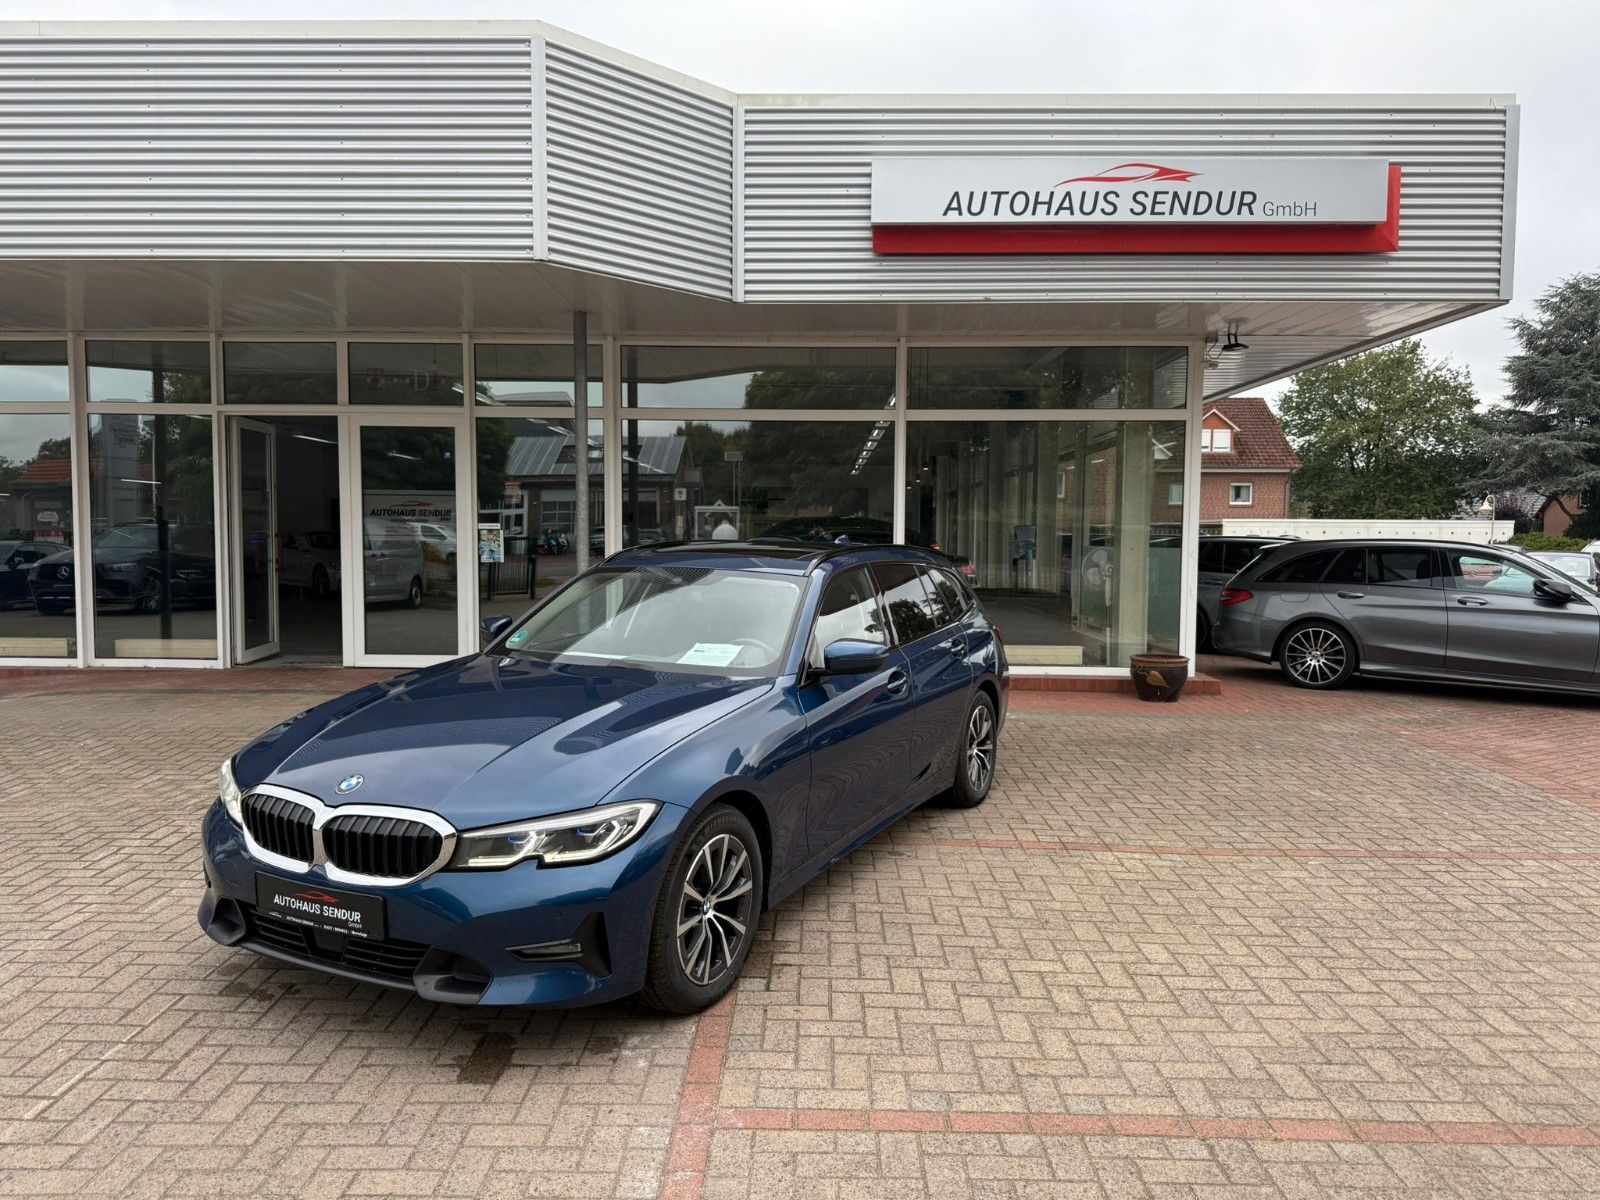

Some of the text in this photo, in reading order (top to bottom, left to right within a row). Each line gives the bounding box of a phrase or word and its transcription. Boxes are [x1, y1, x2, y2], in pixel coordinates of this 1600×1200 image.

[943, 191, 1317, 217] AUTOHAUS SENDUR GmbH
[370, 508, 452, 517] AUTOHAUS SENDUR
[273, 894, 321, 915] AUTOHAUS
[323, 905, 361, 923] SENDUR
